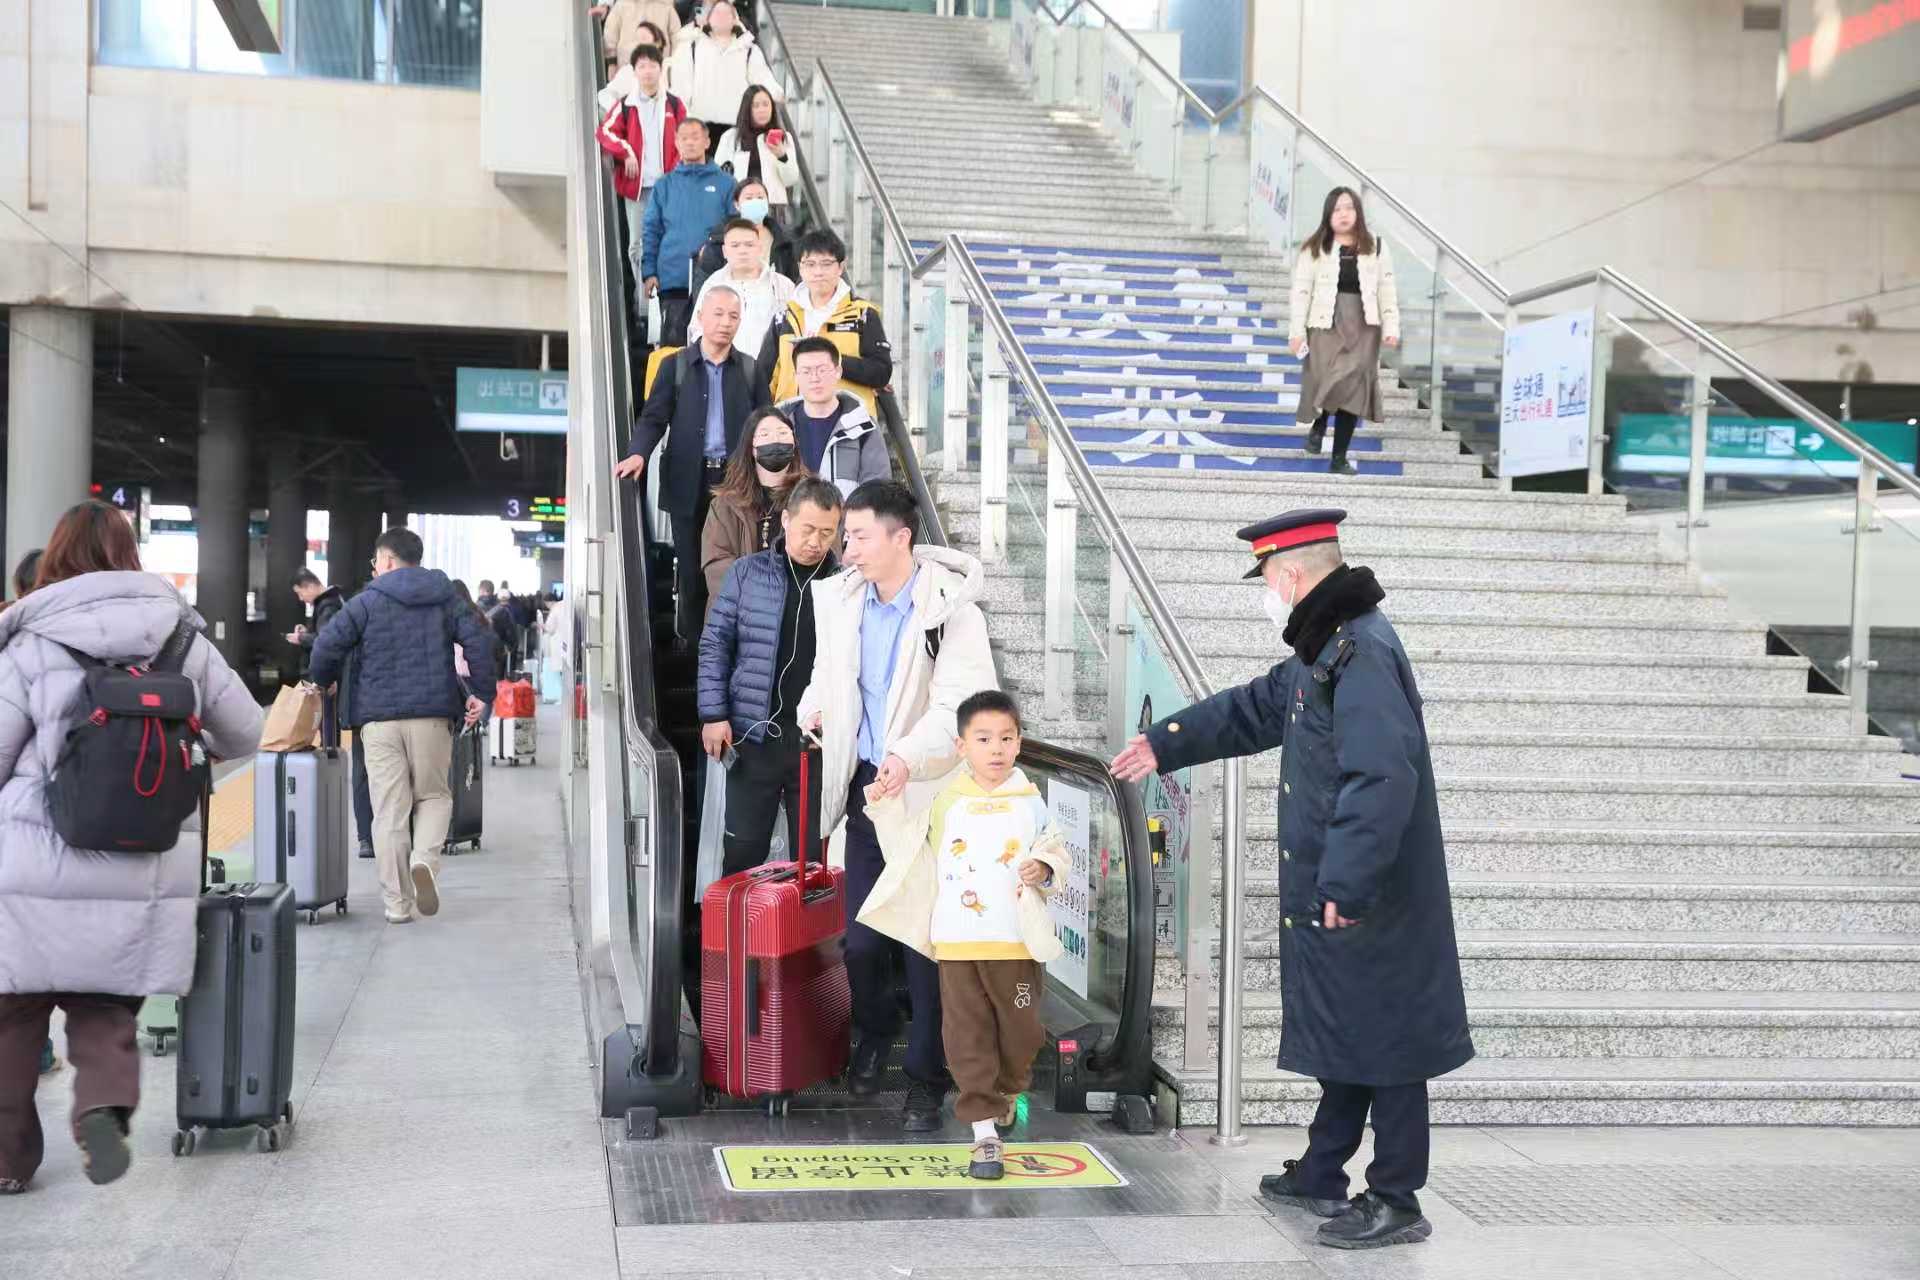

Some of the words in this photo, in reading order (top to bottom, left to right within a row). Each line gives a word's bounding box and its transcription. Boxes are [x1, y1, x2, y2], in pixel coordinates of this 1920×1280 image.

[1512, 373, 1544, 401] 全球通
[112, 488, 126, 506] 4
[507, 499, 520, 517] 3
[762, 1155, 901, 1164] Stopping
[909, 1155, 950, 1163] No
[751, 1165, 972, 1180] 禁止停留
